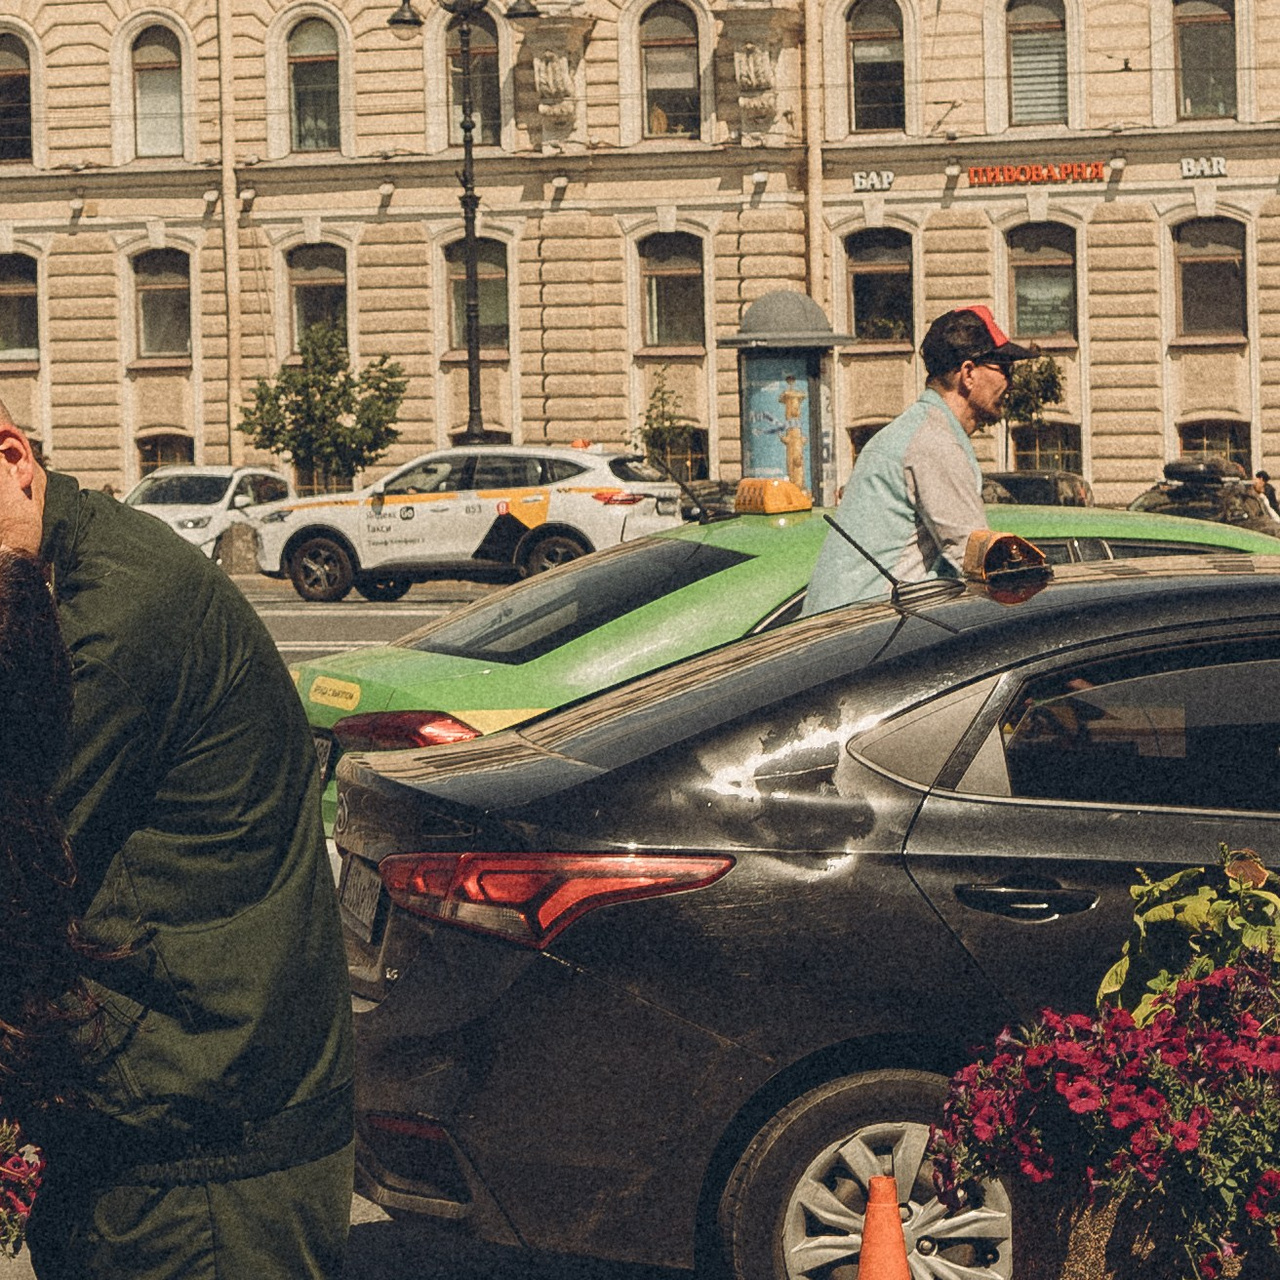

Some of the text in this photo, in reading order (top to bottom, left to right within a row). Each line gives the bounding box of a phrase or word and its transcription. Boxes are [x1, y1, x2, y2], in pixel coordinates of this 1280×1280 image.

[968, 161, 1104, 185] ПИВОВАРНЯ
[1180, 157, 1227, 177] BAR
[853, 171, 894, 190] БАР
